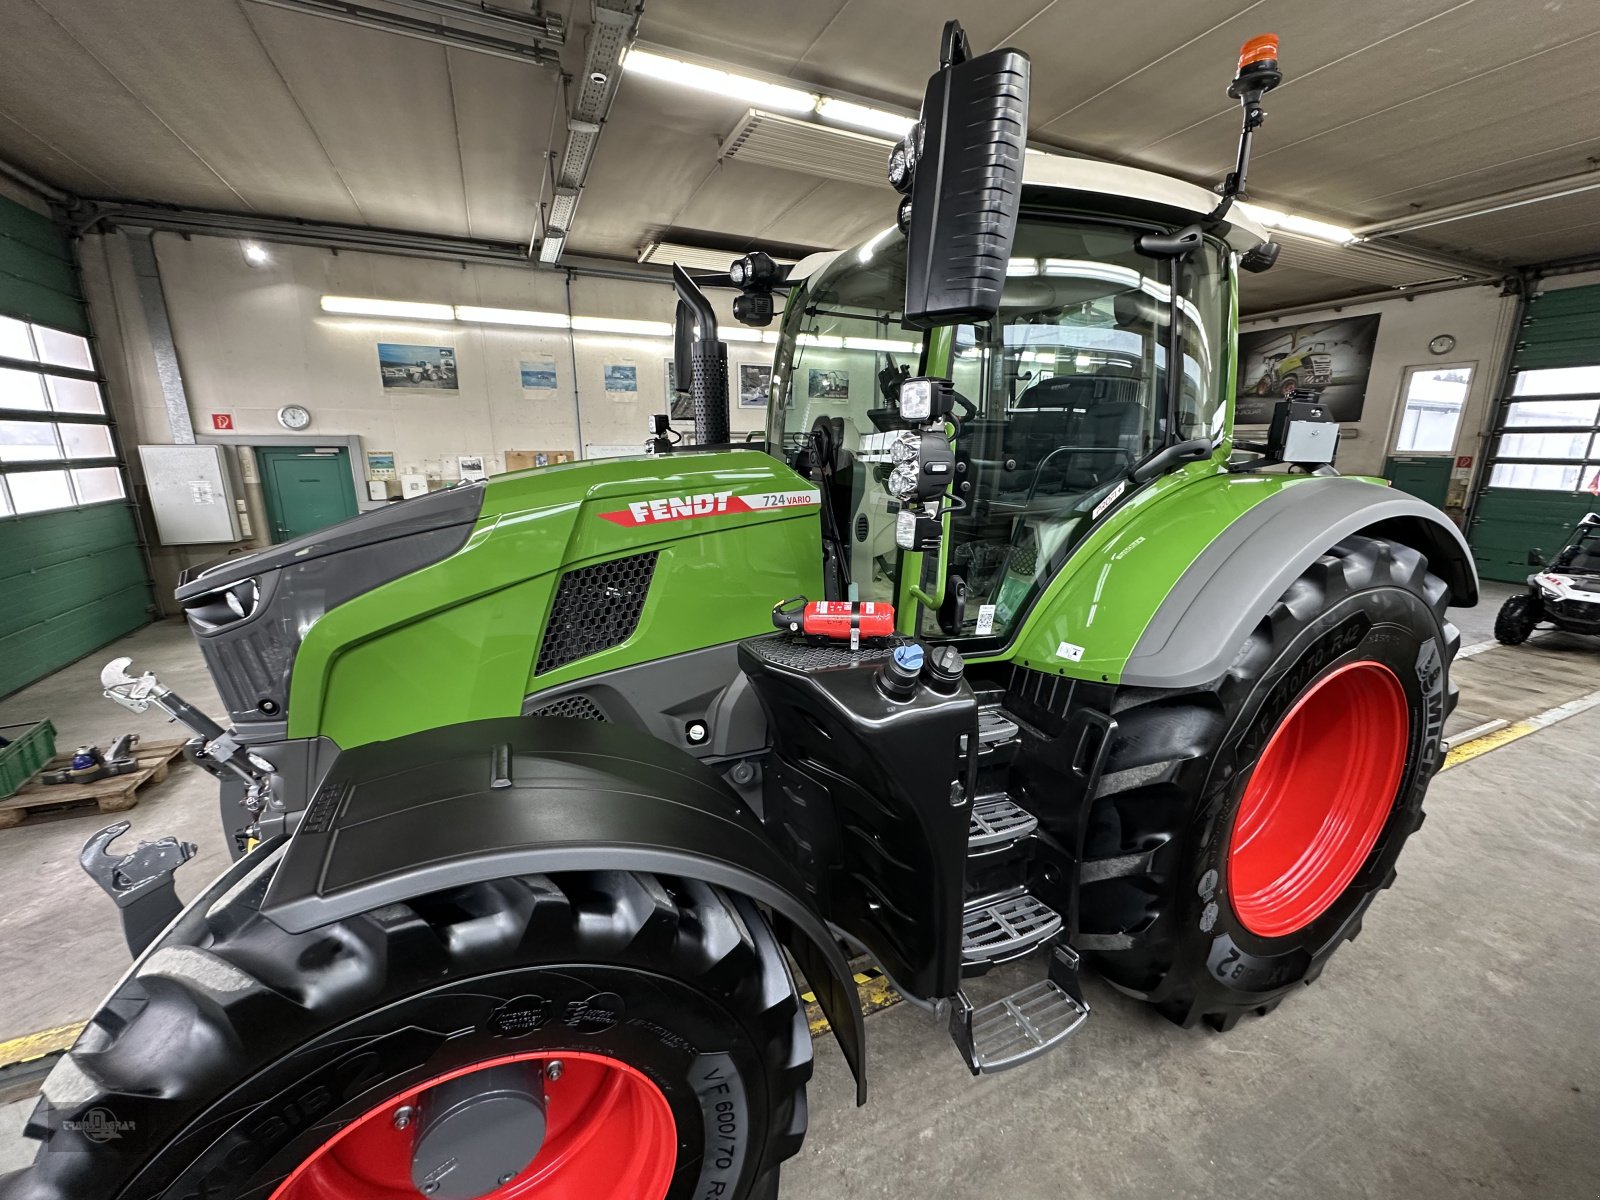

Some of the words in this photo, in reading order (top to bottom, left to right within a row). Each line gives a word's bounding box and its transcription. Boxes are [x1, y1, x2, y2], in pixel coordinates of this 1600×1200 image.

[628, 490, 733, 523] FENDT
[762, 494, 785, 507] 724
[785, 495, 811, 506] VARIO
[703, 1067, 730, 1094] VF
[715, 1101, 736, 1170] 600/70
